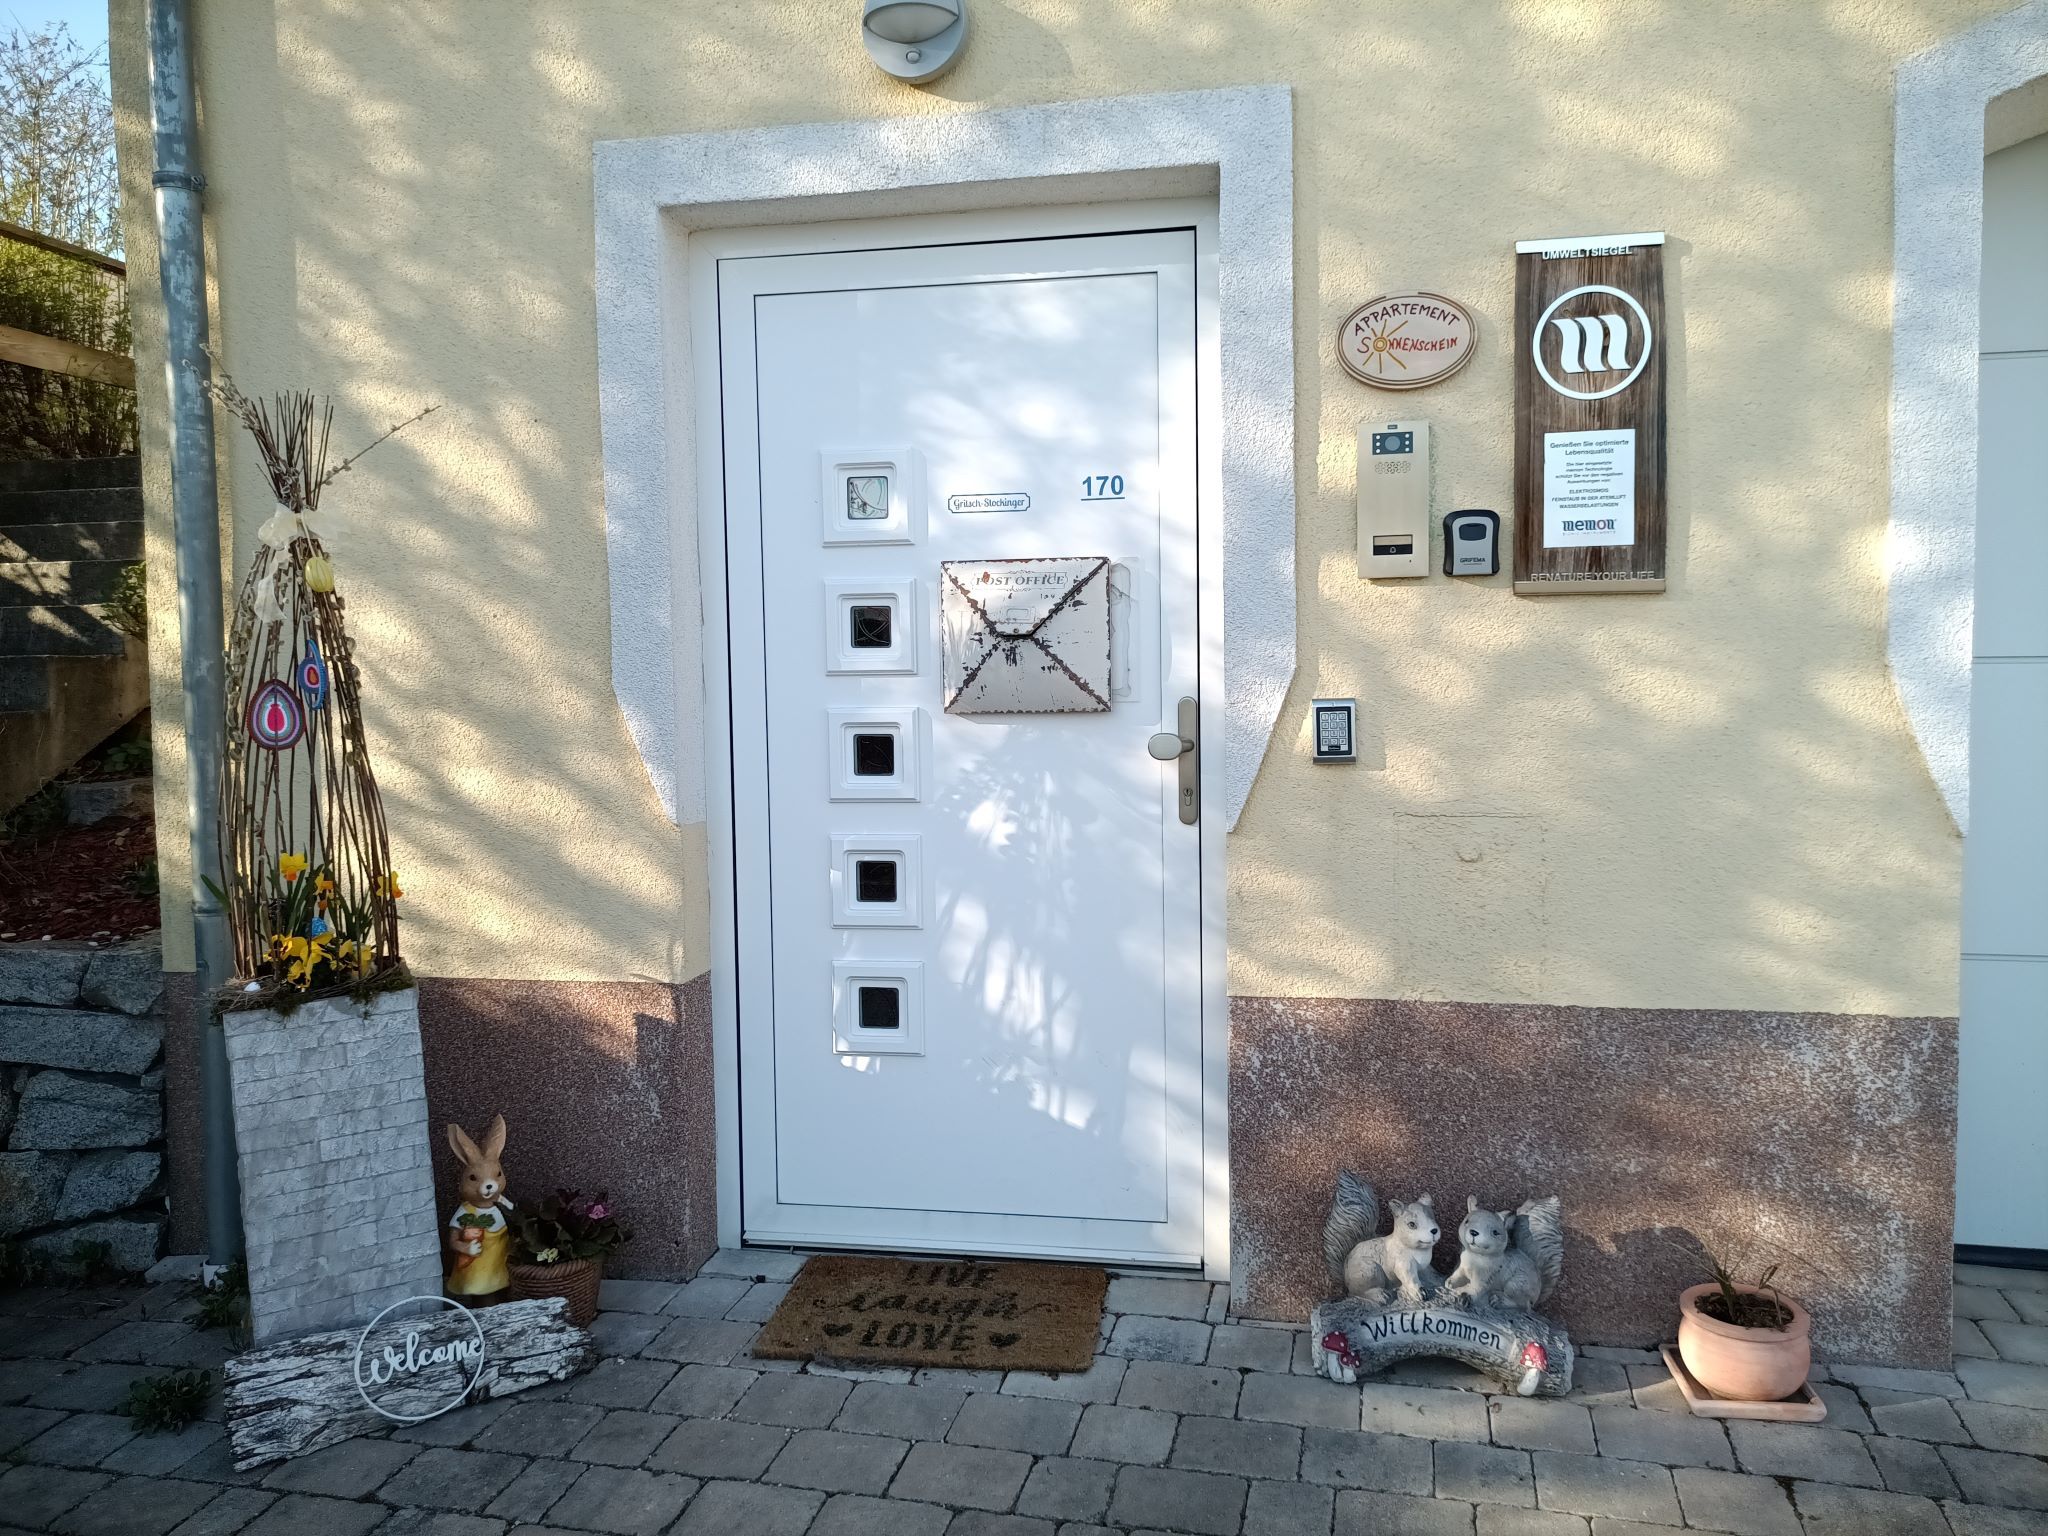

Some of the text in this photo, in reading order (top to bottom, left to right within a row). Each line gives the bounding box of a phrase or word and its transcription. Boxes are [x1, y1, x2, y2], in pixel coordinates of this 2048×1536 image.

[1542, 245, 1632, 260] UMWELTSIEGEL
[1354, 303, 1460, 336] APPARTEMENT
[1082, 475, 1124, 496] 170
[1562, 519, 1615, 531] memon
[1015, 575, 1065, 585] OFFICE
[1531, 571, 1654, 582] RENATURE YOUR LIFE
[859, 1320, 977, 1351] LOVE
[1361, 1312, 1500, 1350] Willkommen
[354, 1332, 485, 1388] Welcome
